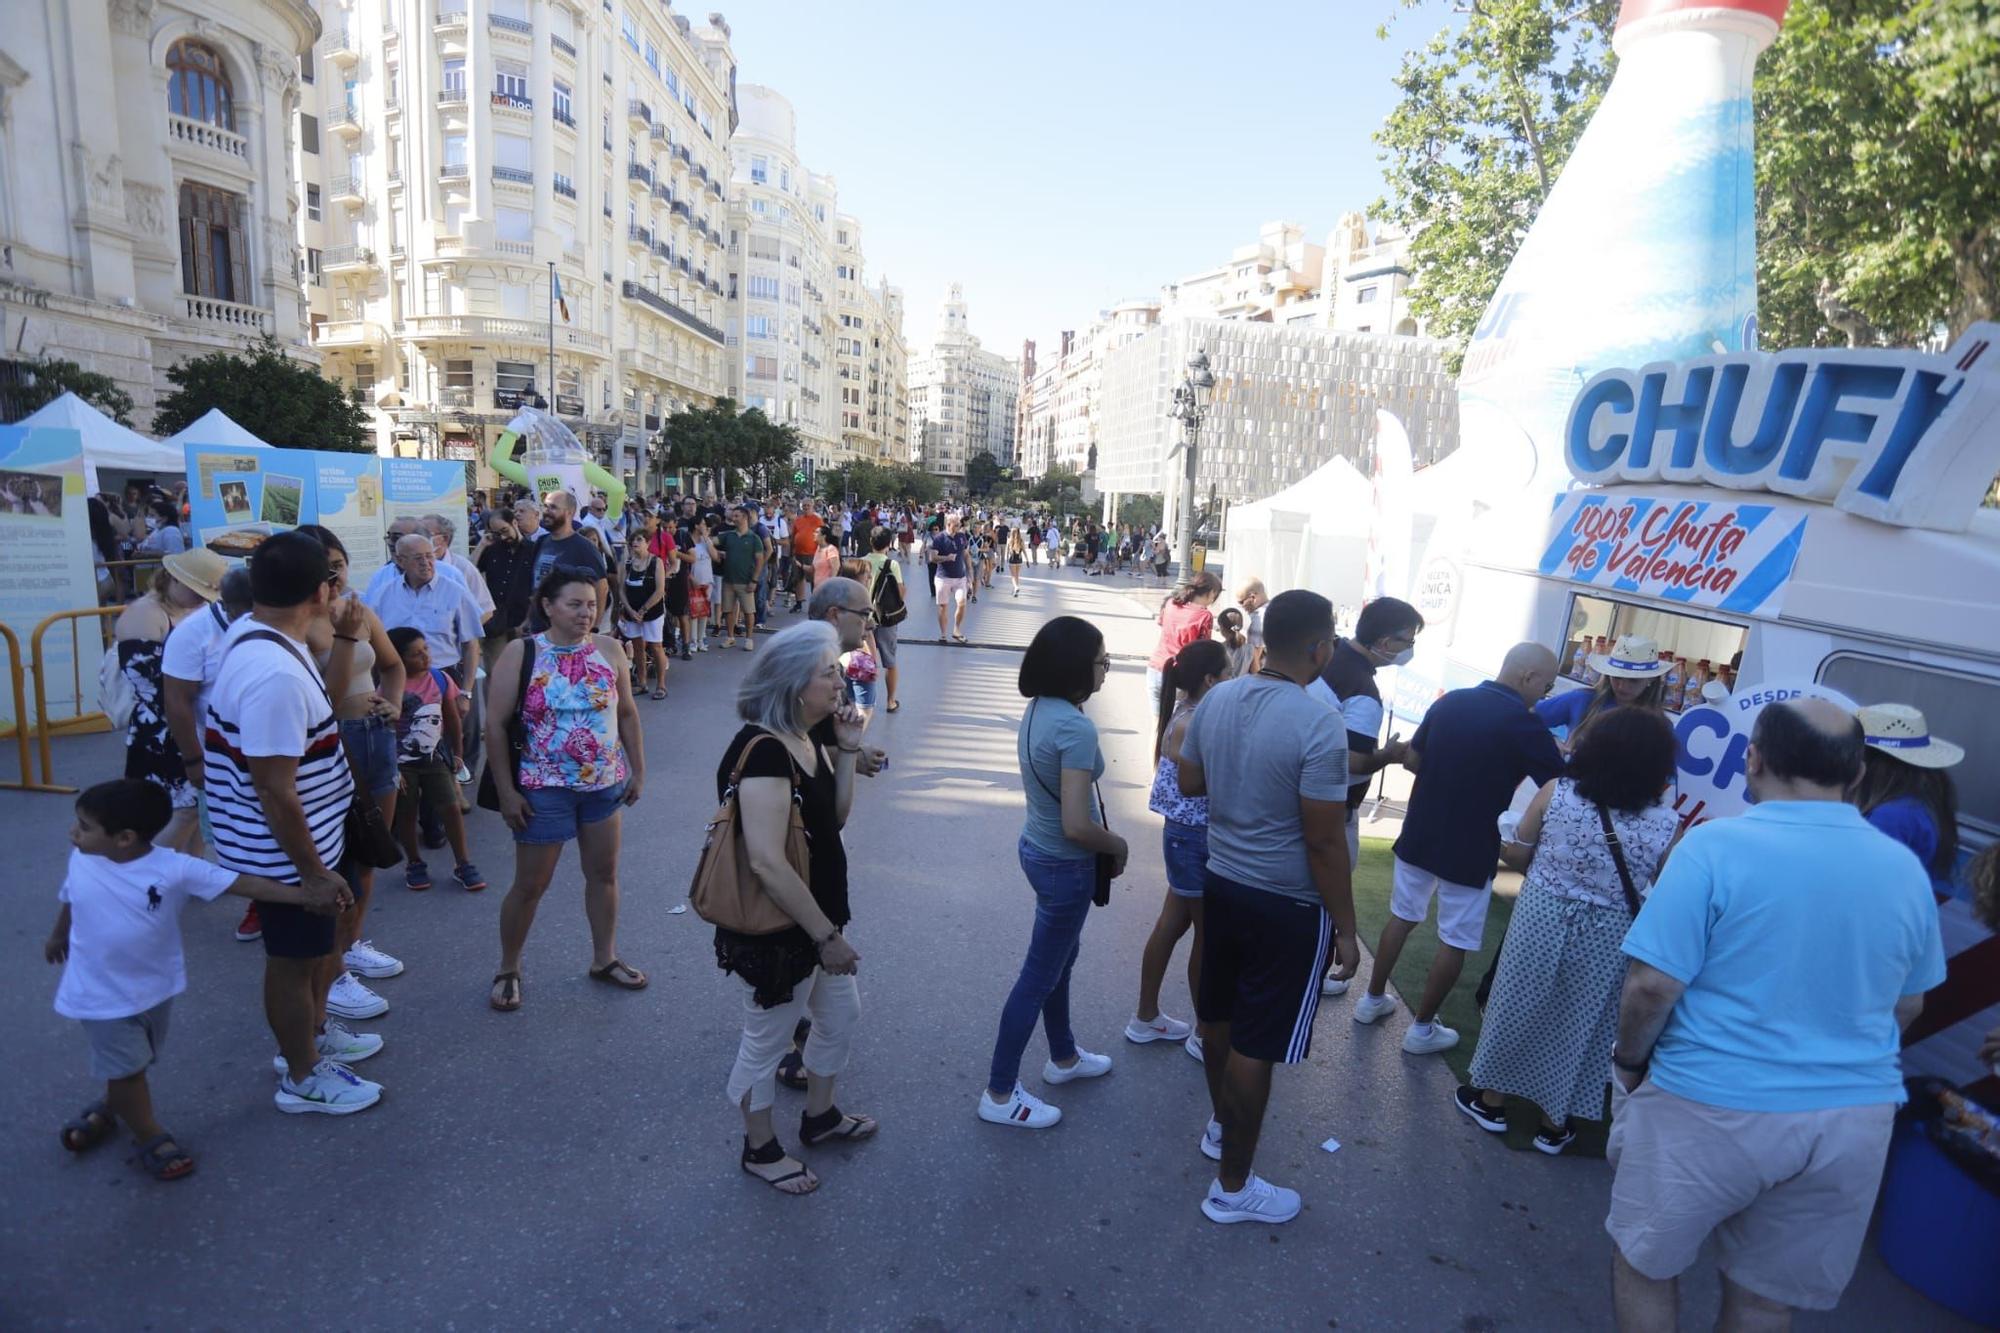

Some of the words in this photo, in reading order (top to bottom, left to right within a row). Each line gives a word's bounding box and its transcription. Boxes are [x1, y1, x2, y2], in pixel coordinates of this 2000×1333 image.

[1574, 506, 1634, 542] 100%
[1641, 505, 1746, 562] Chufa
[1567, 534, 1597, 573] de
[1607, 541, 1738, 594] Valencia
